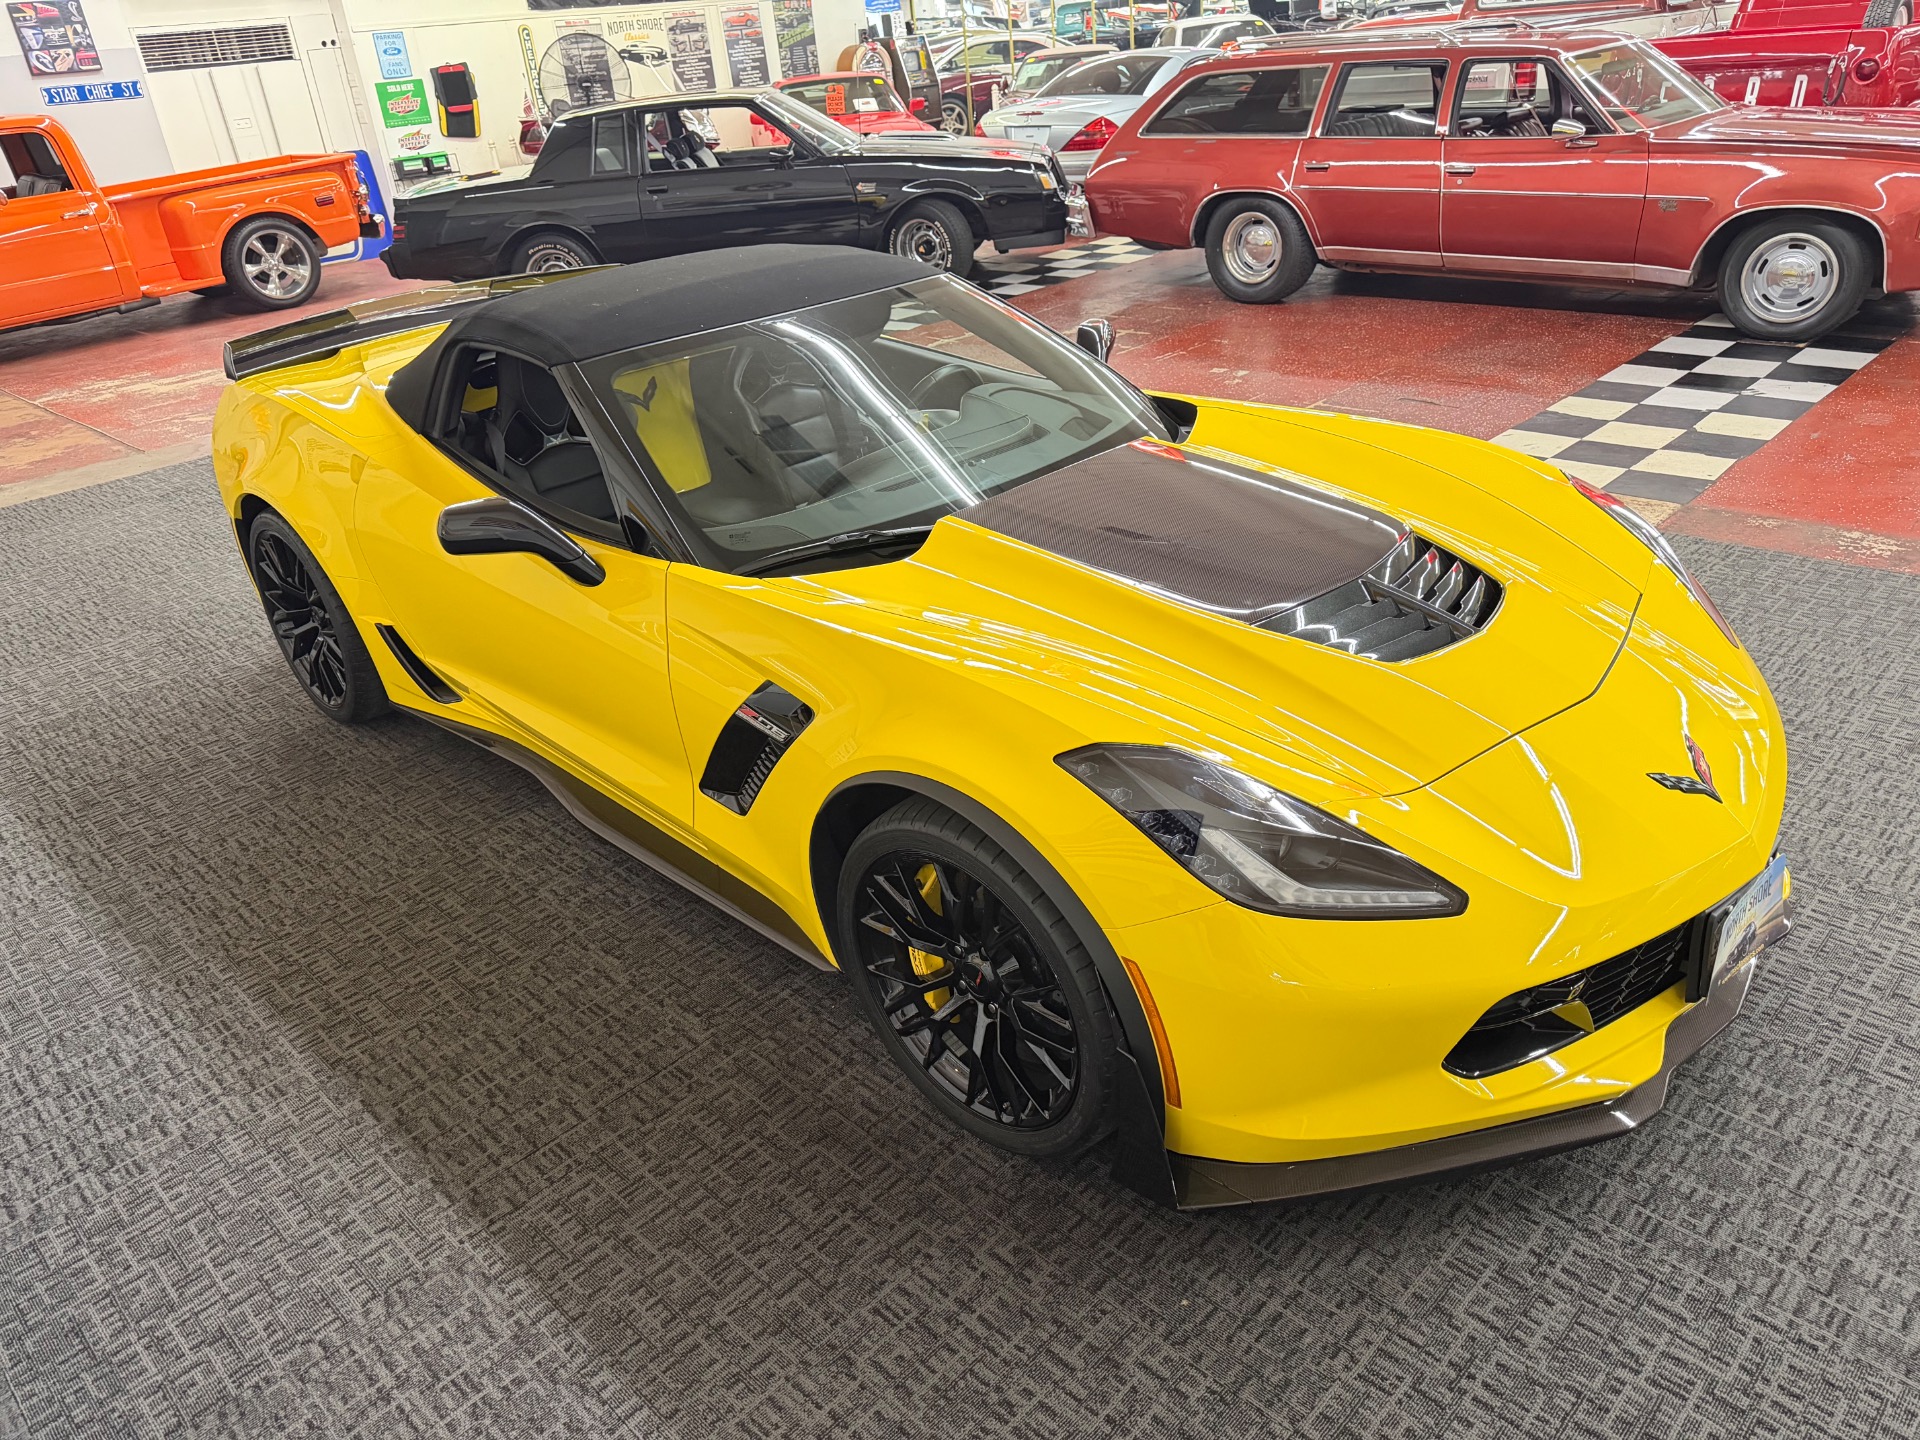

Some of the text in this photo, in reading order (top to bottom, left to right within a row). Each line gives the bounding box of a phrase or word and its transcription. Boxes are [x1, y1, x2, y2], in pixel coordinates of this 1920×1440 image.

[606, 20, 635, 36] NORTH
[636, 17, 664, 31] SHORE
[50, 82, 135, 103] STAR CHIEF ST
[386, 83, 415, 92] SOLD HERE
[388, 99, 420, 107] INTERSTATE
[390, 104, 419, 112] BATTERIES
[397, 133, 431, 143] INTERSTATE
[400, 140, 430, 149] BATTERIES
[934, 220, 952, 251] Radial
[528, 243, 555, 255] Radial
[556, 244, 569, 253] T/A
[739, 703, 790, 740] Z06
[1723, 906, 1747, 947] NORTH
[1748, 874, 1773, 912] SHORE
